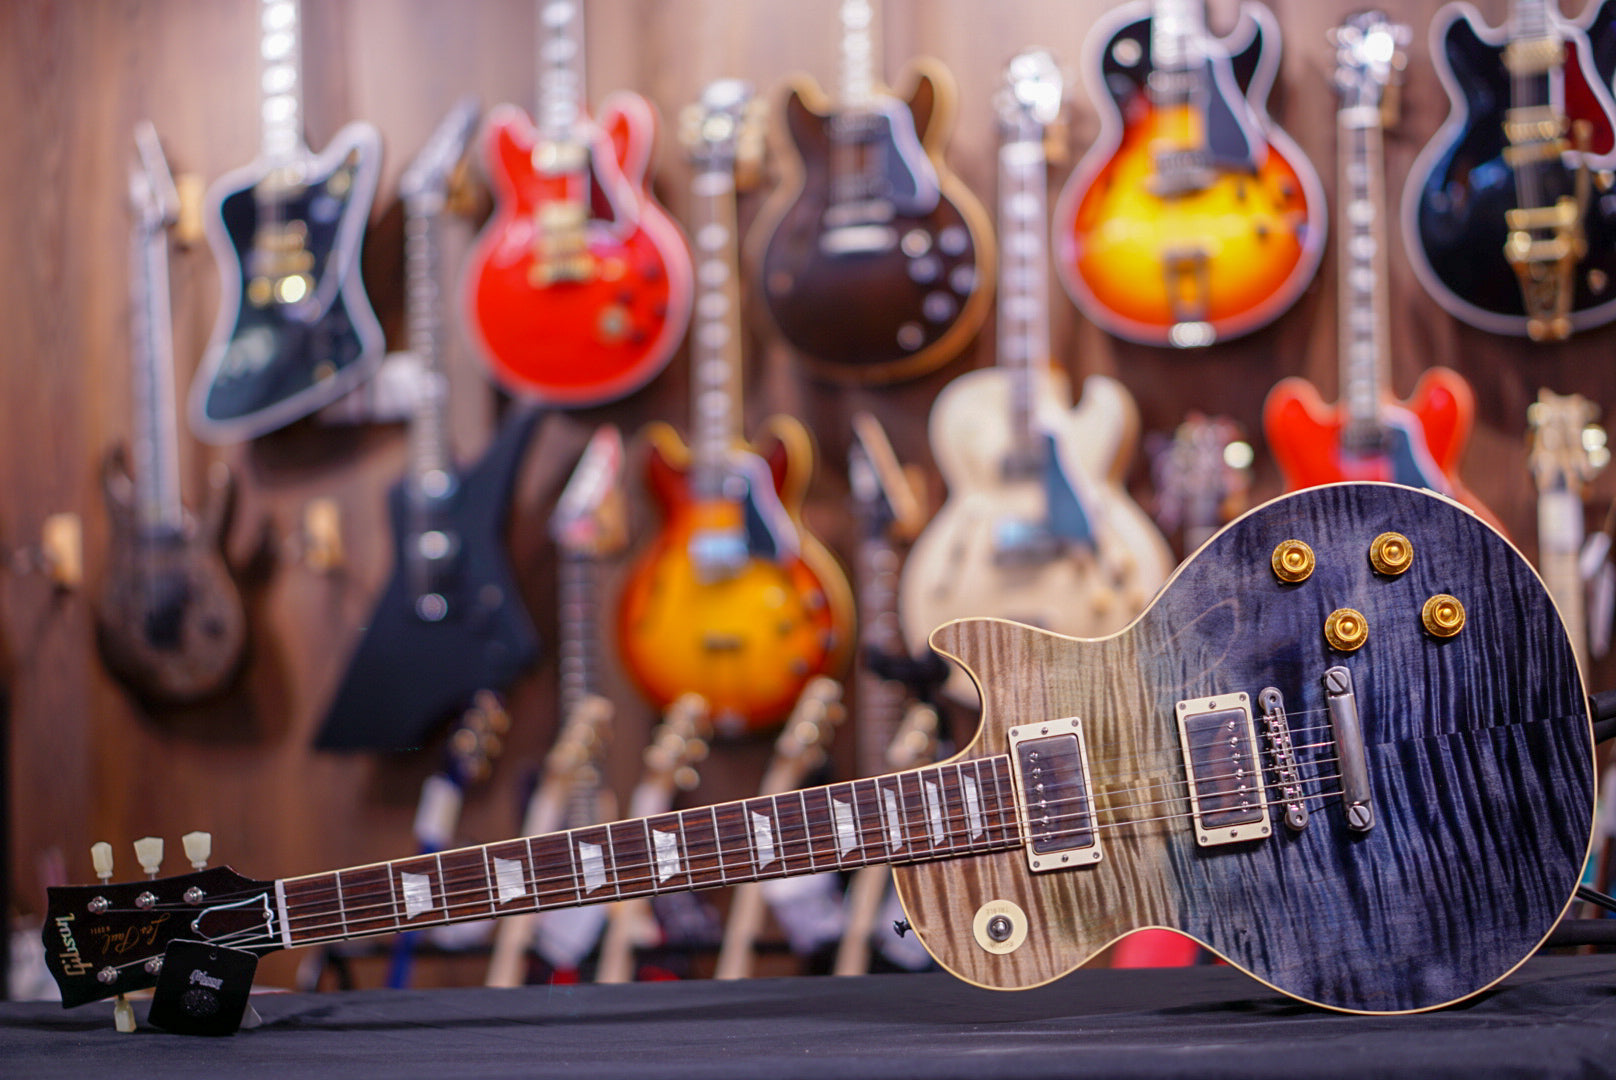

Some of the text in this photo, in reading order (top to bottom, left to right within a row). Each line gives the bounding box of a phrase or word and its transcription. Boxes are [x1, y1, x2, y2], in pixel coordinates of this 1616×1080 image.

[54, 912, 94, 976] Gibson
[101, 912, 171, 955] Les Paul
